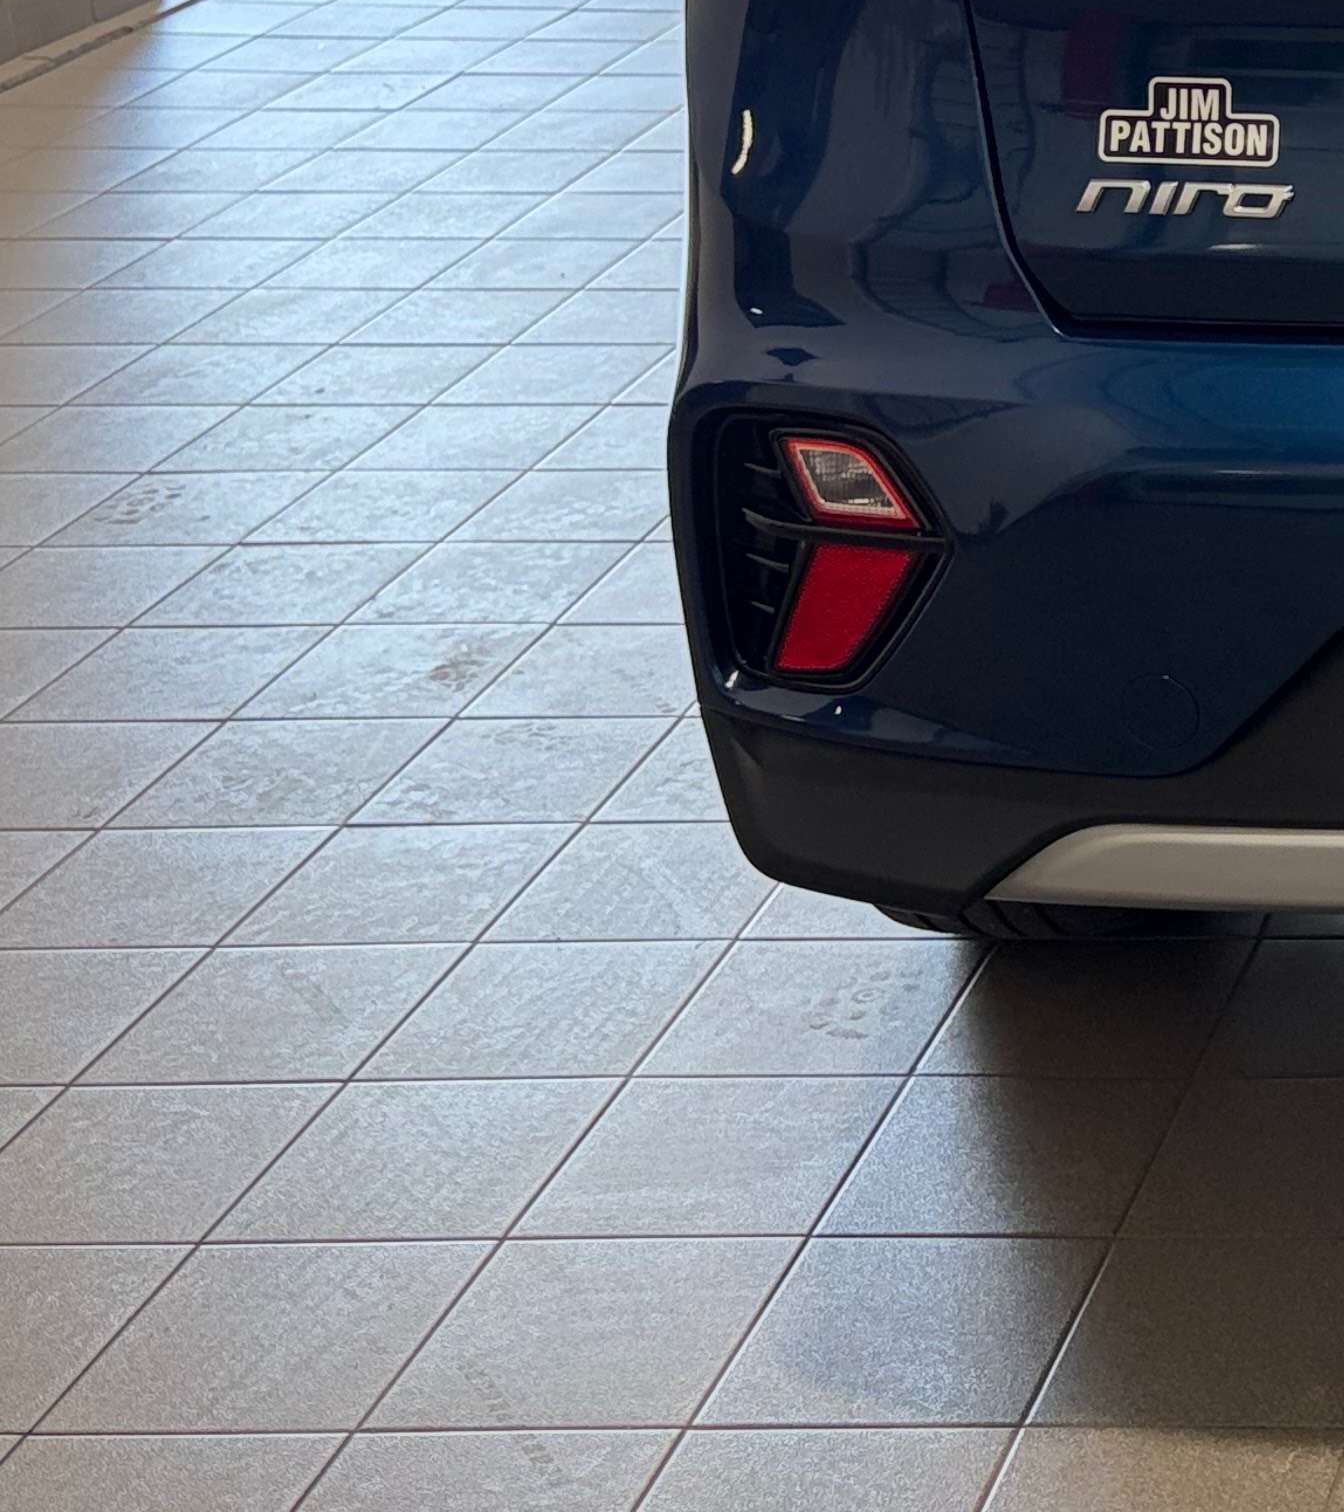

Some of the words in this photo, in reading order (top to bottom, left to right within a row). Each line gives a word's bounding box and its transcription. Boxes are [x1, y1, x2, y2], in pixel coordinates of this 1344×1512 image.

[1160, 87, 1220, 121] JIM
[1110, 119, 1268, 157] PATTISON
[1075, 178, 1295, 219] niro
